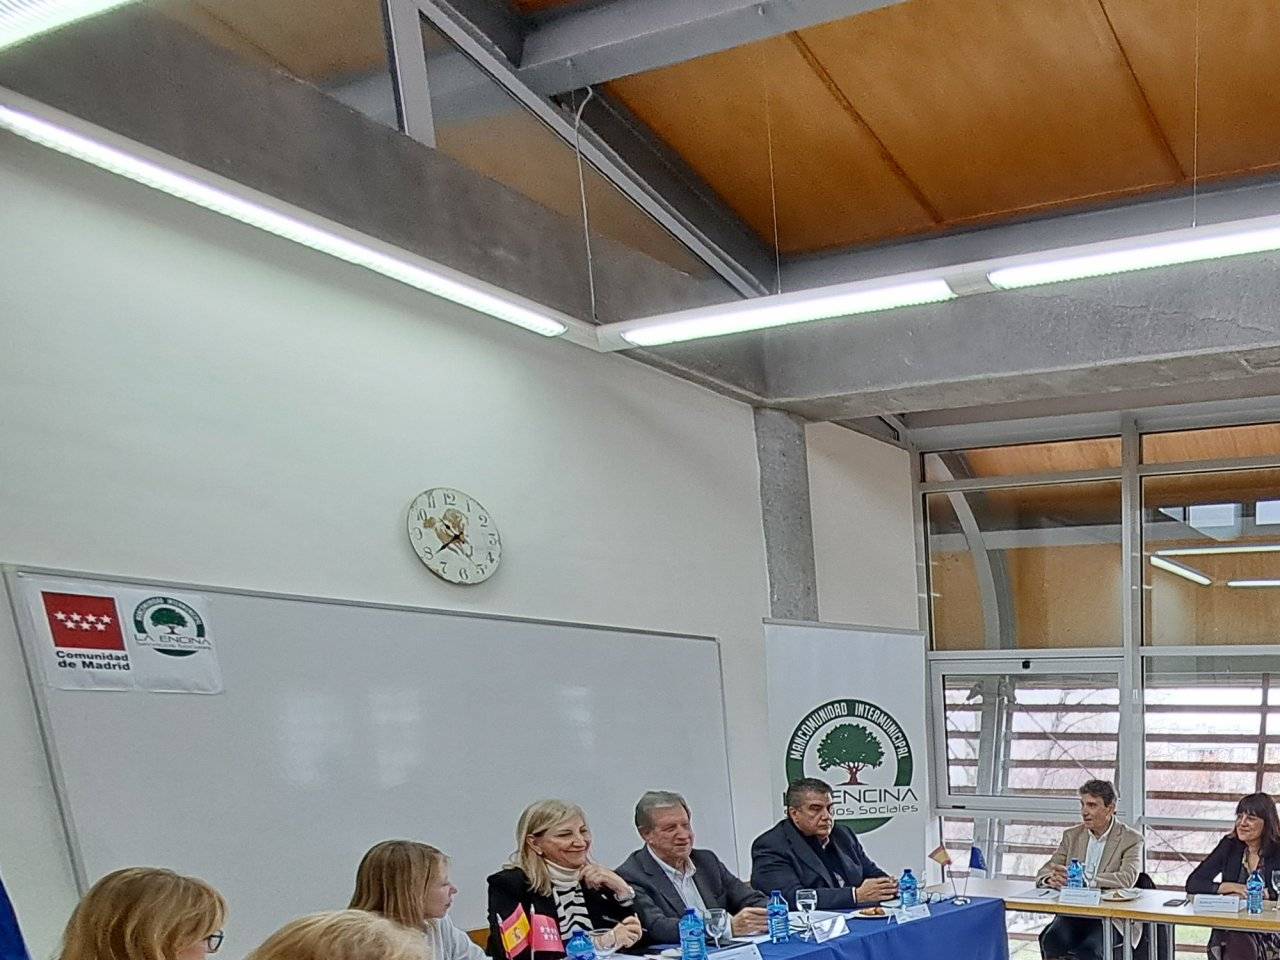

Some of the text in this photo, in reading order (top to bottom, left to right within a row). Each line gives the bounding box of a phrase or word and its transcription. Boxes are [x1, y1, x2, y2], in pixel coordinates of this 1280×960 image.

[443, 493, 456, 506] 12
[478, 515, 488, 527] 2
[424, 546, 434, 560] 8
[440, 560, 448, 574] 7
[56, 650, 129, 662] Comunidad
[58, 660, 131, 671] de Madrid
[790, 702, 909, 760] MANCOMUNIDAD INTERMUNICIPAL
[858, 804, 919, 816] Sociales
